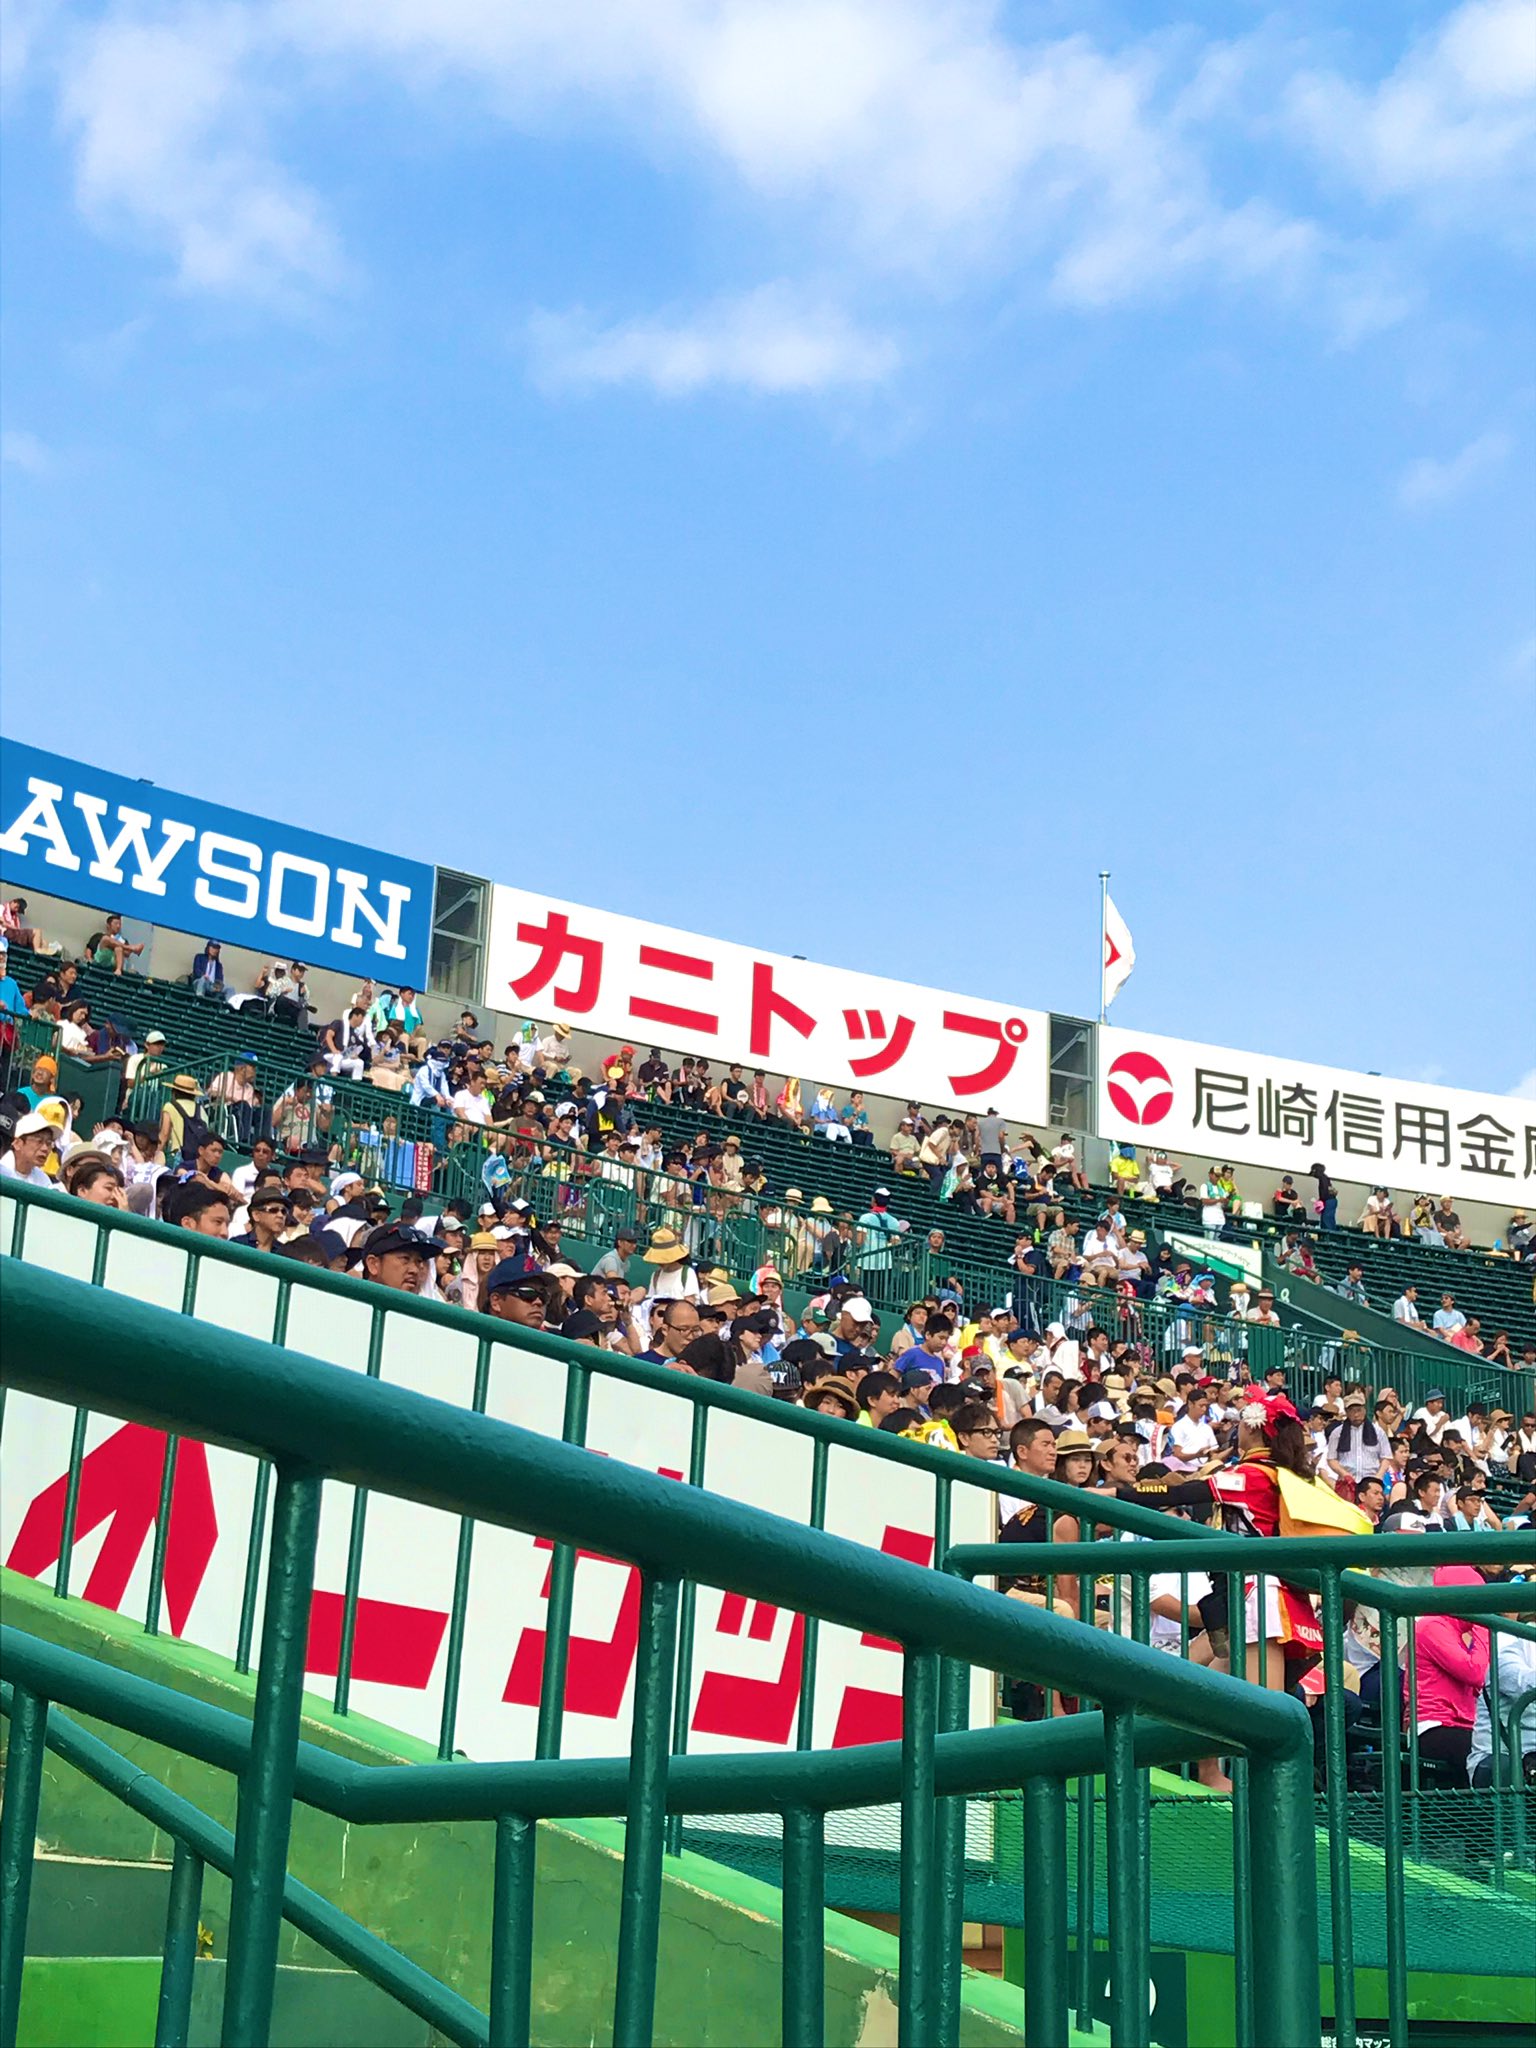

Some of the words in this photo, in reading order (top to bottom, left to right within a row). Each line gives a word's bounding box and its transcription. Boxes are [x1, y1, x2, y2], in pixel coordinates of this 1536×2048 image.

[0, 776, 412, 961] AWSON
[508, 911, 1029, 1096] カニトップ
[1192, 1067, 1536, 1180] 尼崎信用金
